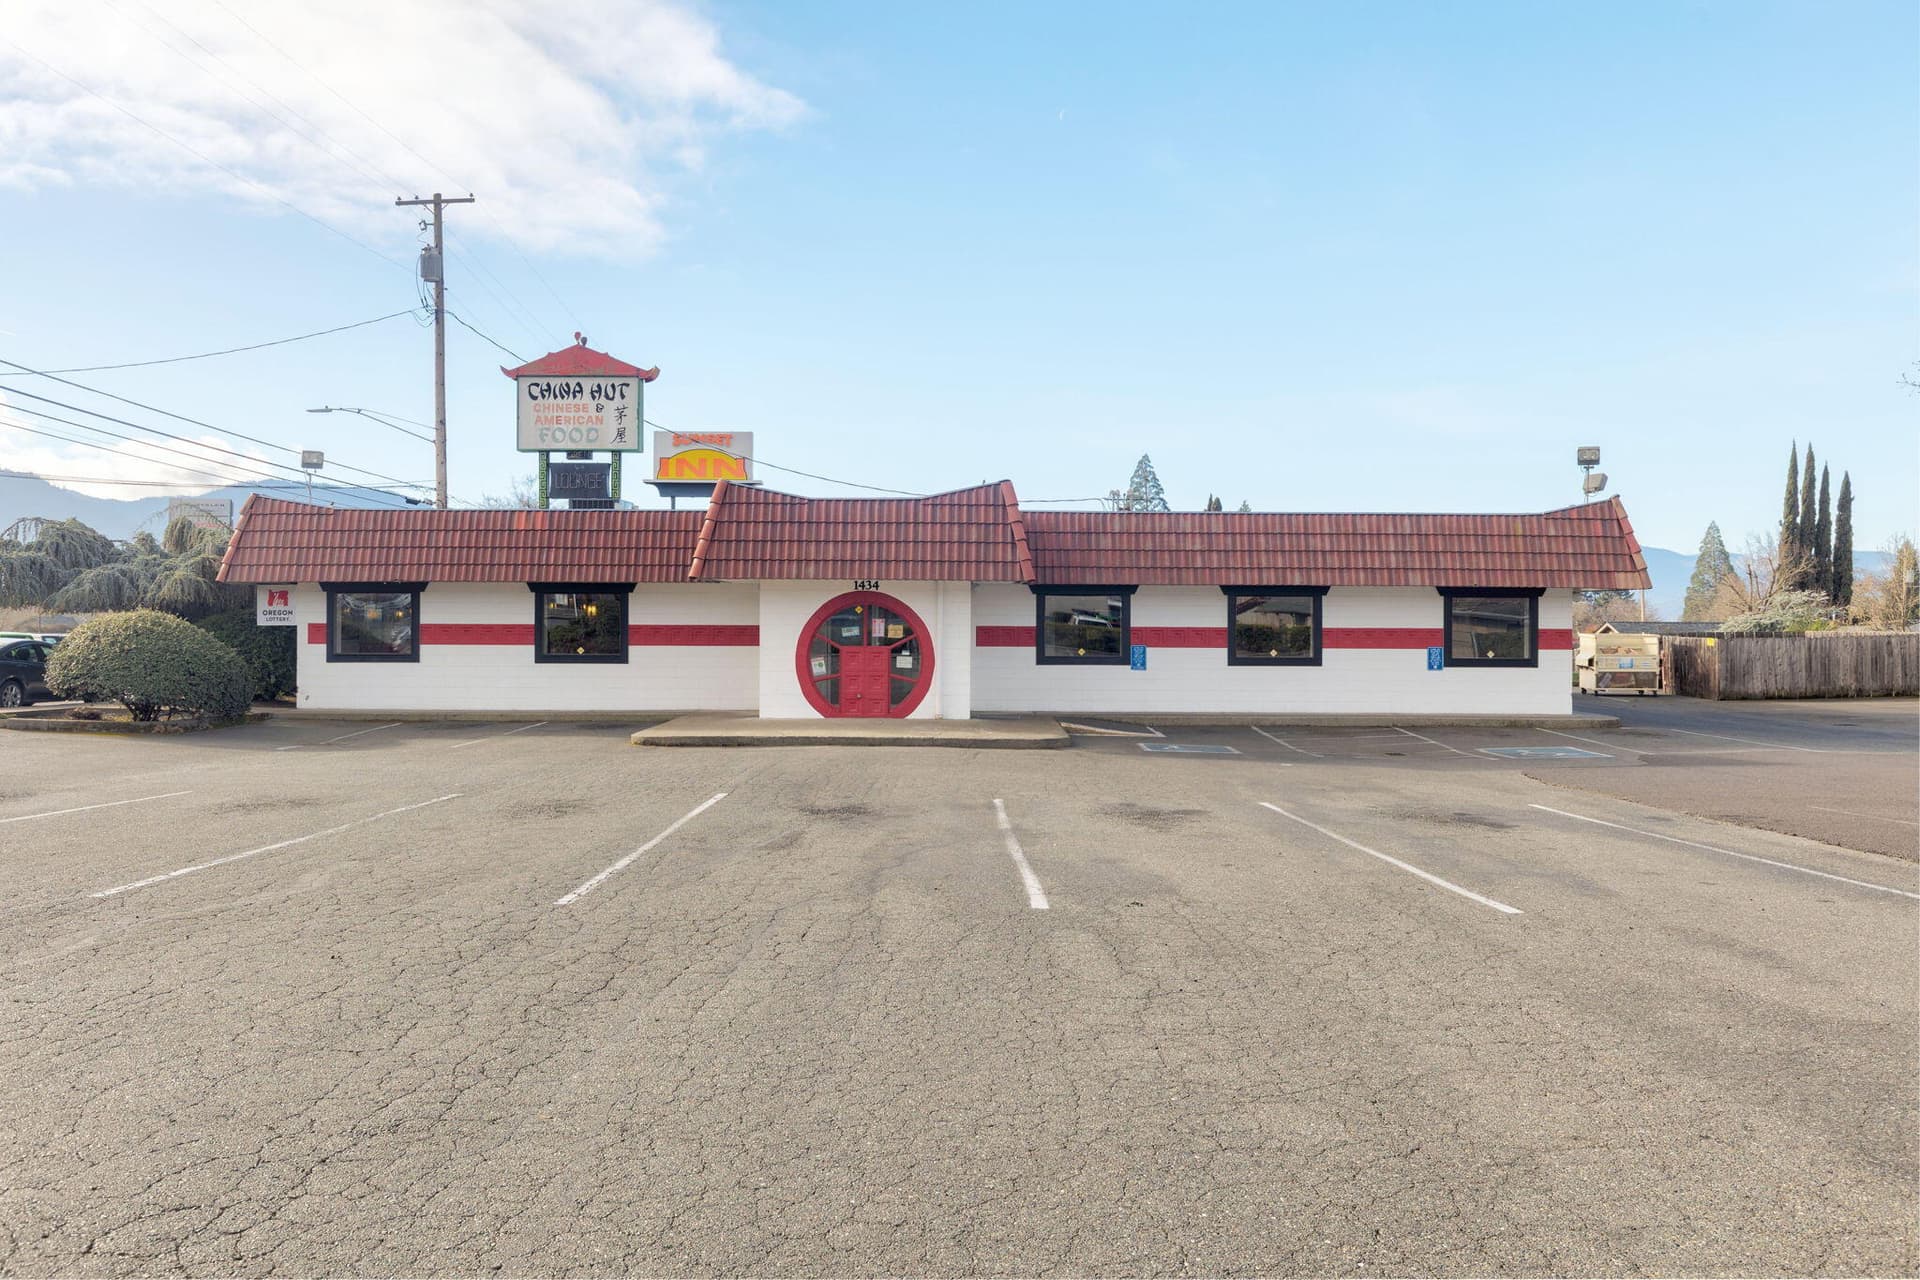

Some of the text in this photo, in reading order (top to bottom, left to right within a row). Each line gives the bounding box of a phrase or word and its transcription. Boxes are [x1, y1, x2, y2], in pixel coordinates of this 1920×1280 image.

[528, 381, 630, 401] CHINA HUT
[533, 403, 604, 413] CHINESE &
[535, 415, 603, 425] AMERICAN
[538, 427, 600, 443] FOOD
[672, 432, 734, 447] SUNSET
[659, 457, 746, 477] INN
[554, 472, 602, 488] LOUNGE
[854, 580, 880, 591] 1434
